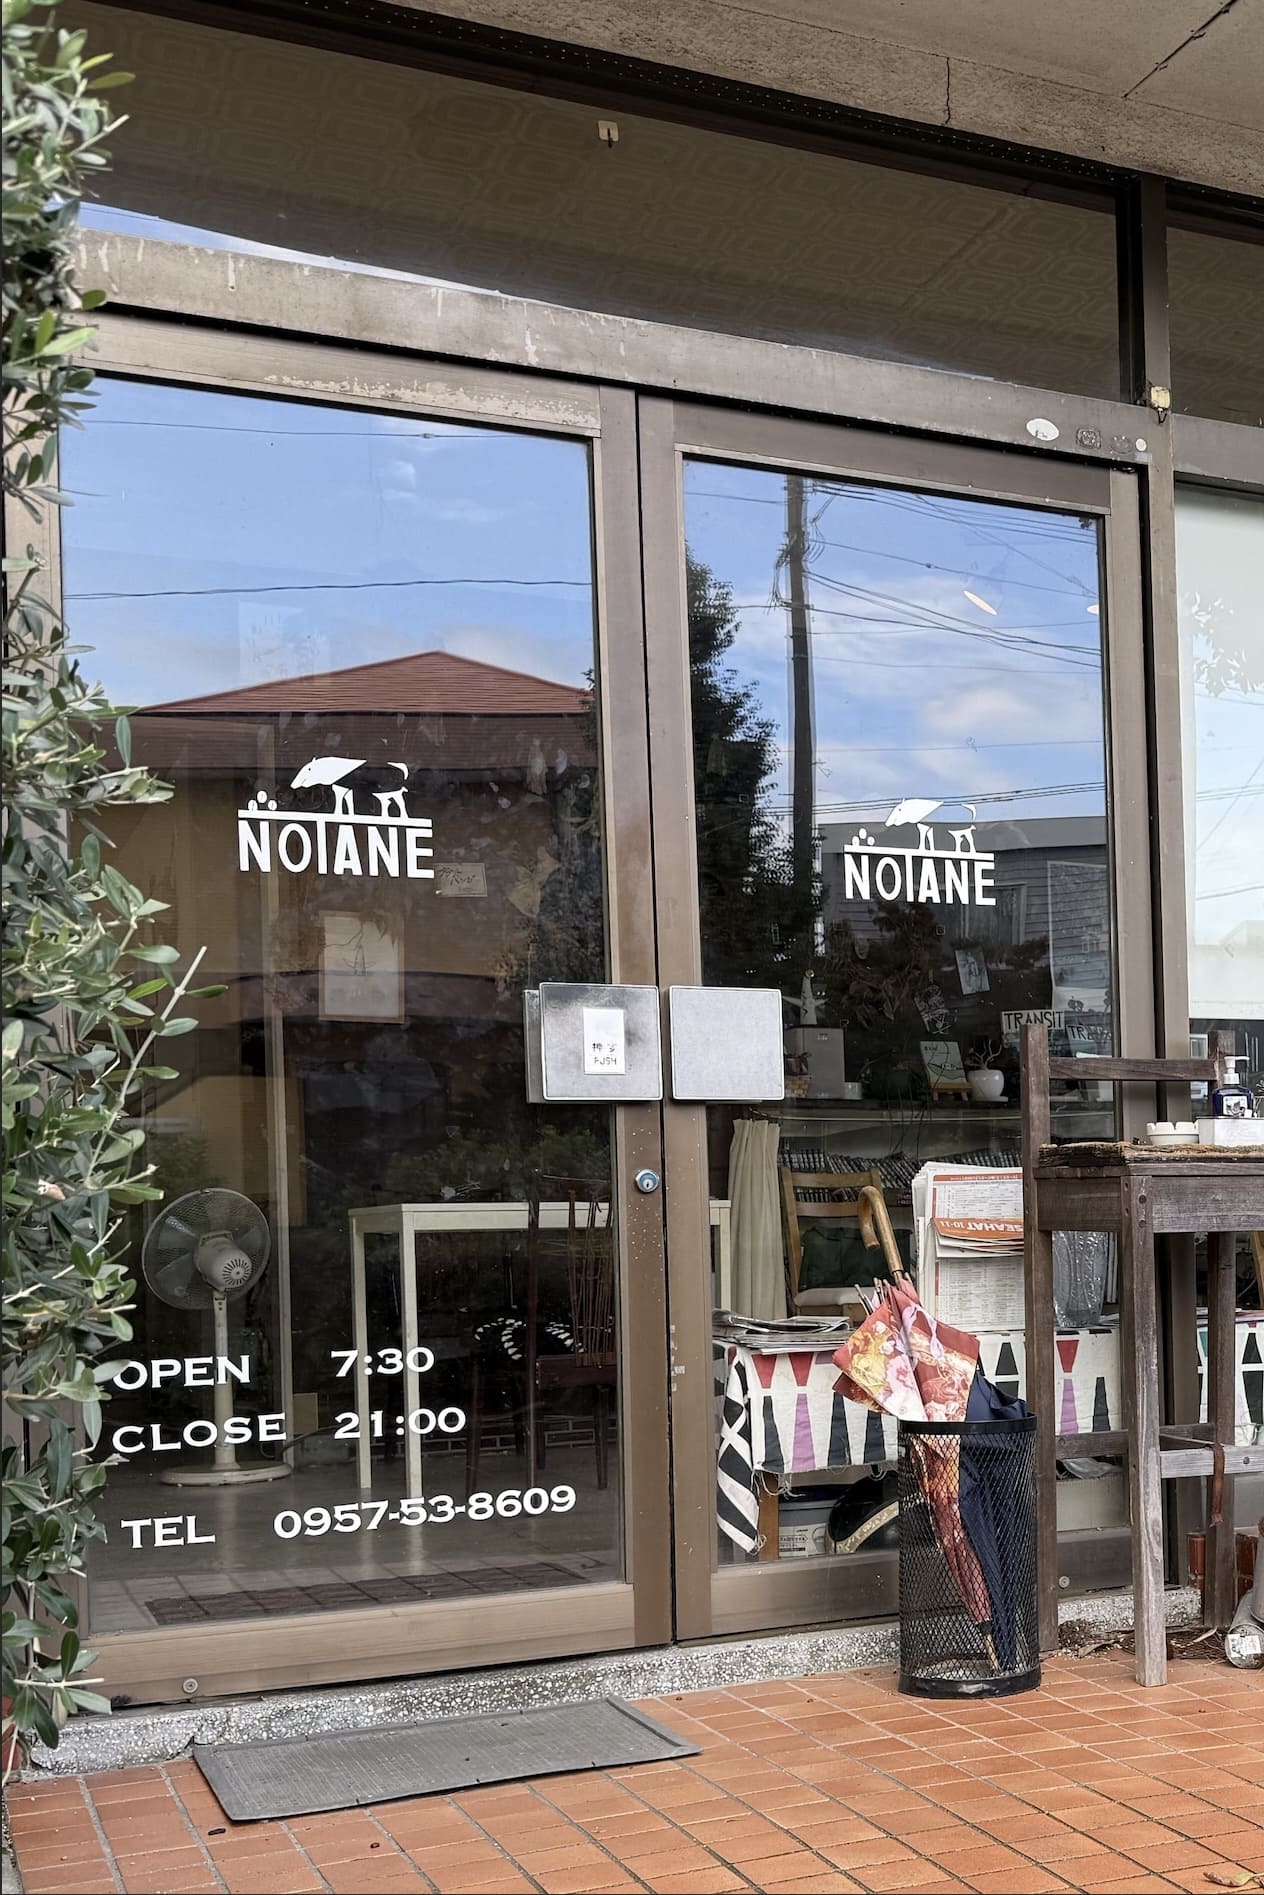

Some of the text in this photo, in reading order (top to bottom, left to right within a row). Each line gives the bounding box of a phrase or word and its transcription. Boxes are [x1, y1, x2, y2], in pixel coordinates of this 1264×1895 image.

[238, 810, 435, 879] NOTANE
[844, 845, 997, 906] NOTANE
[1003, 1011, 1064, 1031] TRANSIT
[113, 1346, 435, 1391] OPEN 7:30
[112, 1406, 467, 1454] CLOSE 21:00
[121, 1484, 577, 1549] TEL 0957-53-8609
